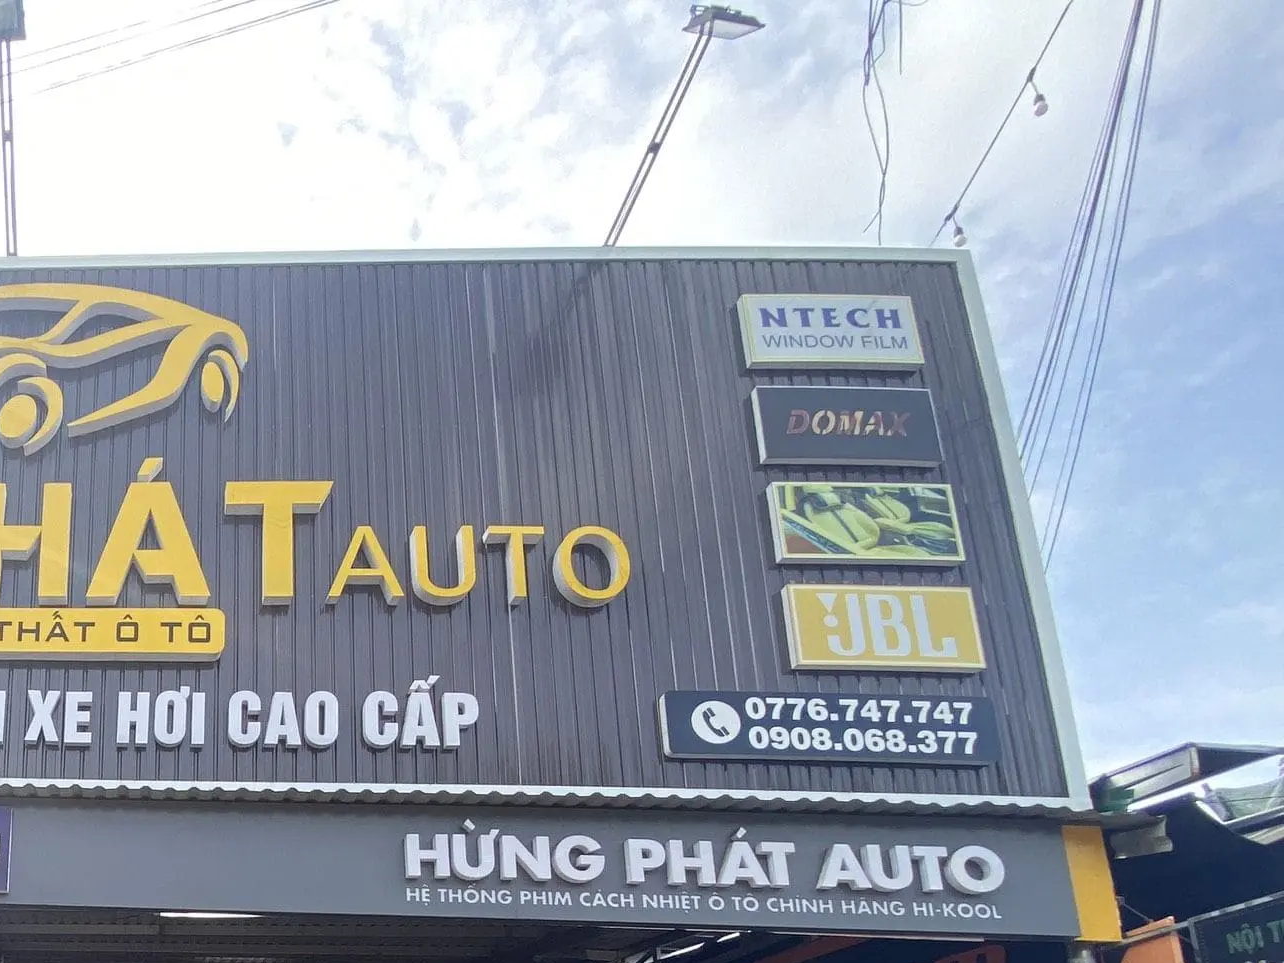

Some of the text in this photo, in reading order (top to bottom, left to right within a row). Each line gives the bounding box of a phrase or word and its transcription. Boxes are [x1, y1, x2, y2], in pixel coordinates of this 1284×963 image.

[758, 306, 903, 330] NTECH
[761, 334, 909, 350] WINDOW FILM
[785, 409, 912, 437] DOMAX
[324, 525, 631, 608] AUTO
[115, 613, 140, 643] Ô
[161, 615, 212, 644] TÔ
[818, 592, 959, 658] JBL
[24, 689, 94, 747] XE
[116, 686, 206, 748] HƠI
[227, 689, 340, 749] CAO
[362, 675, 480, 750] CẤP
[745, 696, 973, 725] 0776.747.747
[748, 726, 978, 755] 0908.068.377
[404, 818, 1006, 895] HỪNG PHÁT AUTO
[406, 884, 431, 906] HỆ
[519, 890, 573, 906] PHIM
[642, 891, 702, 915] NHIỆT
[707, 892, 726, 911] Ô
[731, 893, 760, 912] TÔ
[912, 901, 1003, 920] HI-KOOL
[1226, 923, 1264, 954] NỘI
